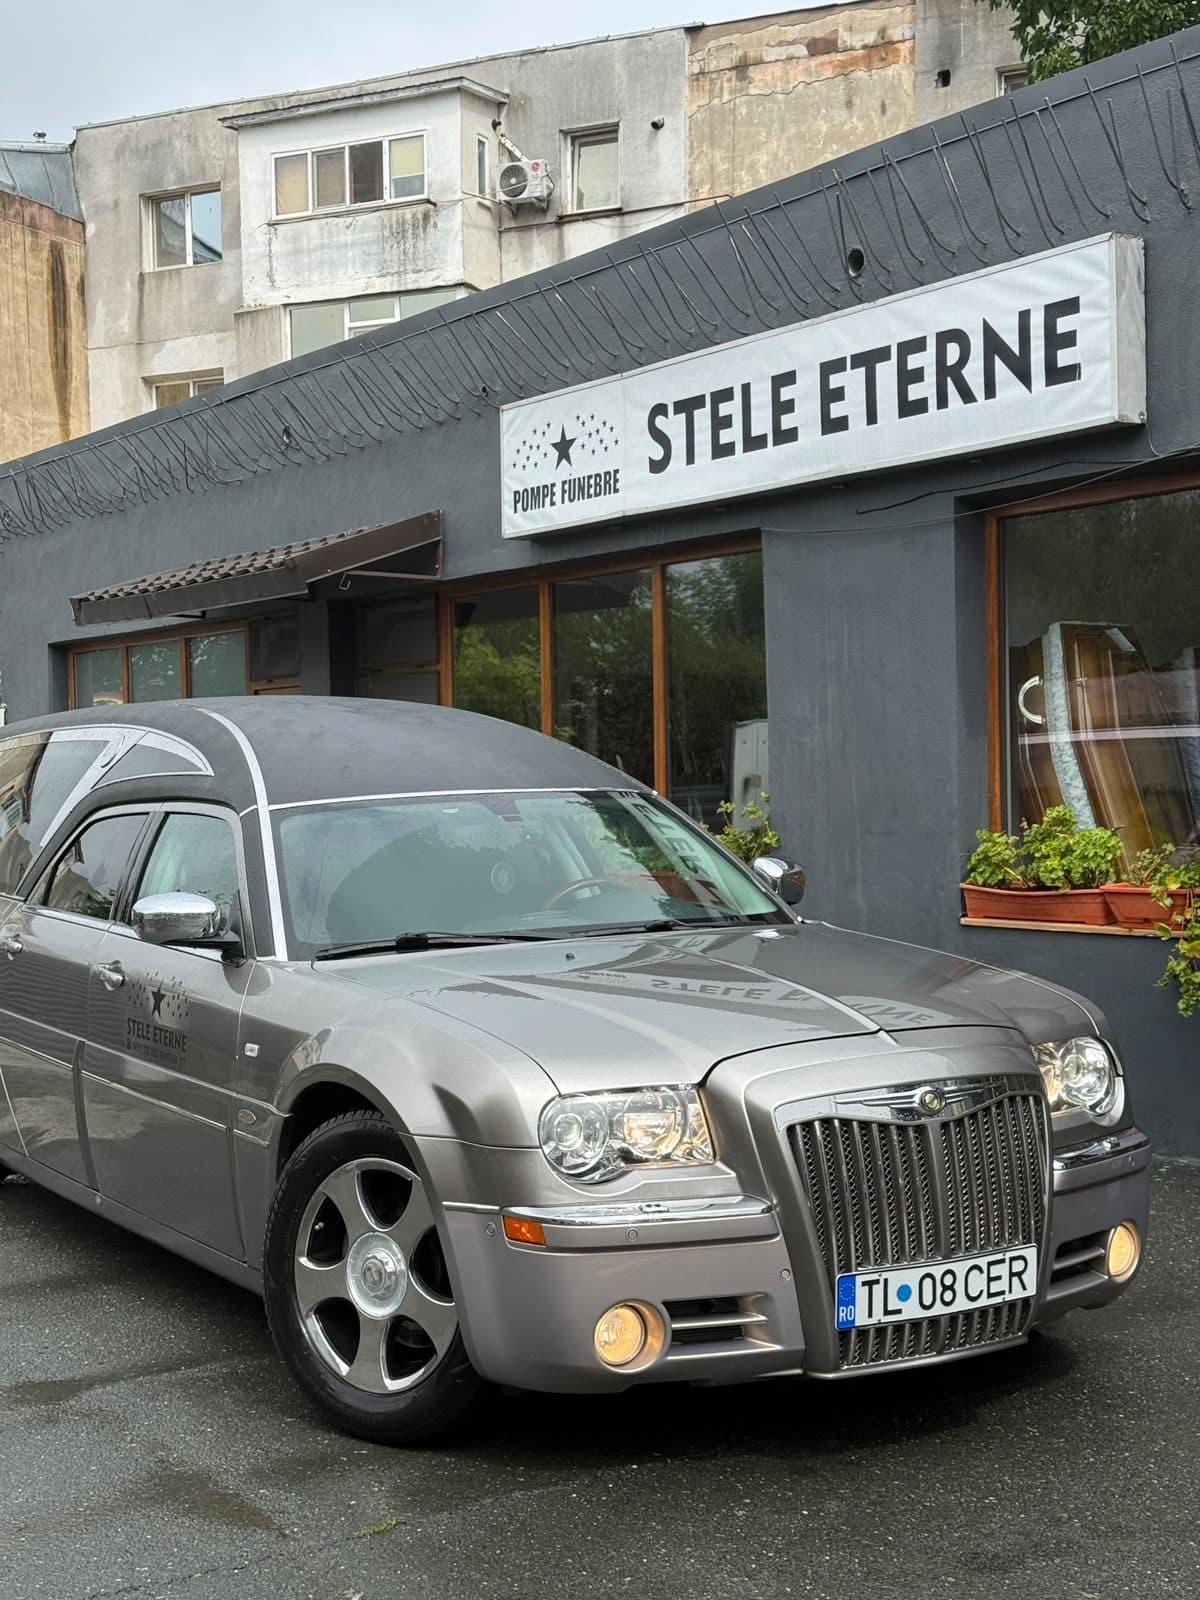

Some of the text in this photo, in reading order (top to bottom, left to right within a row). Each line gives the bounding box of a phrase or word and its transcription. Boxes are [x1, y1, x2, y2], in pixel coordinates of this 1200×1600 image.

[646, 295, 1082, 476] STELE ETERNE
[513, 468, 620, 515] POMPE FUNEBRE
[127, 1017, 187, 1053] STELE ETERNE
[861, 1254, 1029, 1319] TL 08 CER
[839, 1305, 855, 1323] RO
